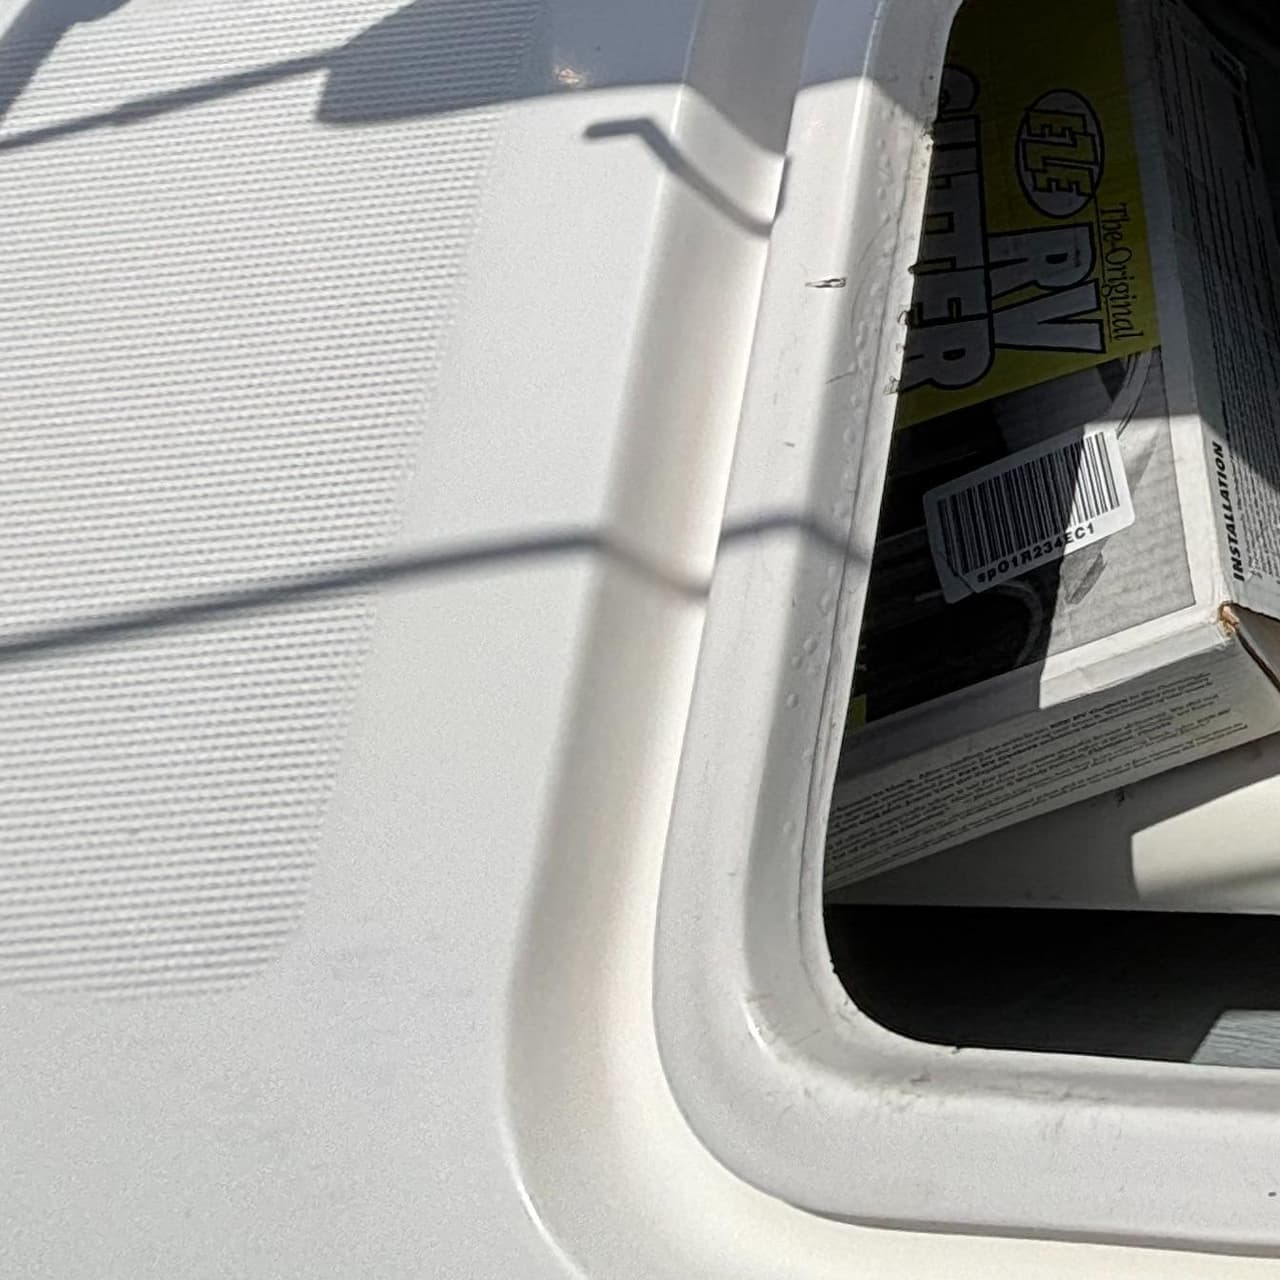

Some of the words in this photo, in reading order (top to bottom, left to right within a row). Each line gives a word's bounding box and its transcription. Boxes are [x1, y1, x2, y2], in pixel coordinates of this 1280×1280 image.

[1100, 202, 1128, 252] The
[986, 222, 1106, 353] RV
[1099, 247, 1145, 342] Original
[1211, 440, 1246, 581] INSTALLATION
